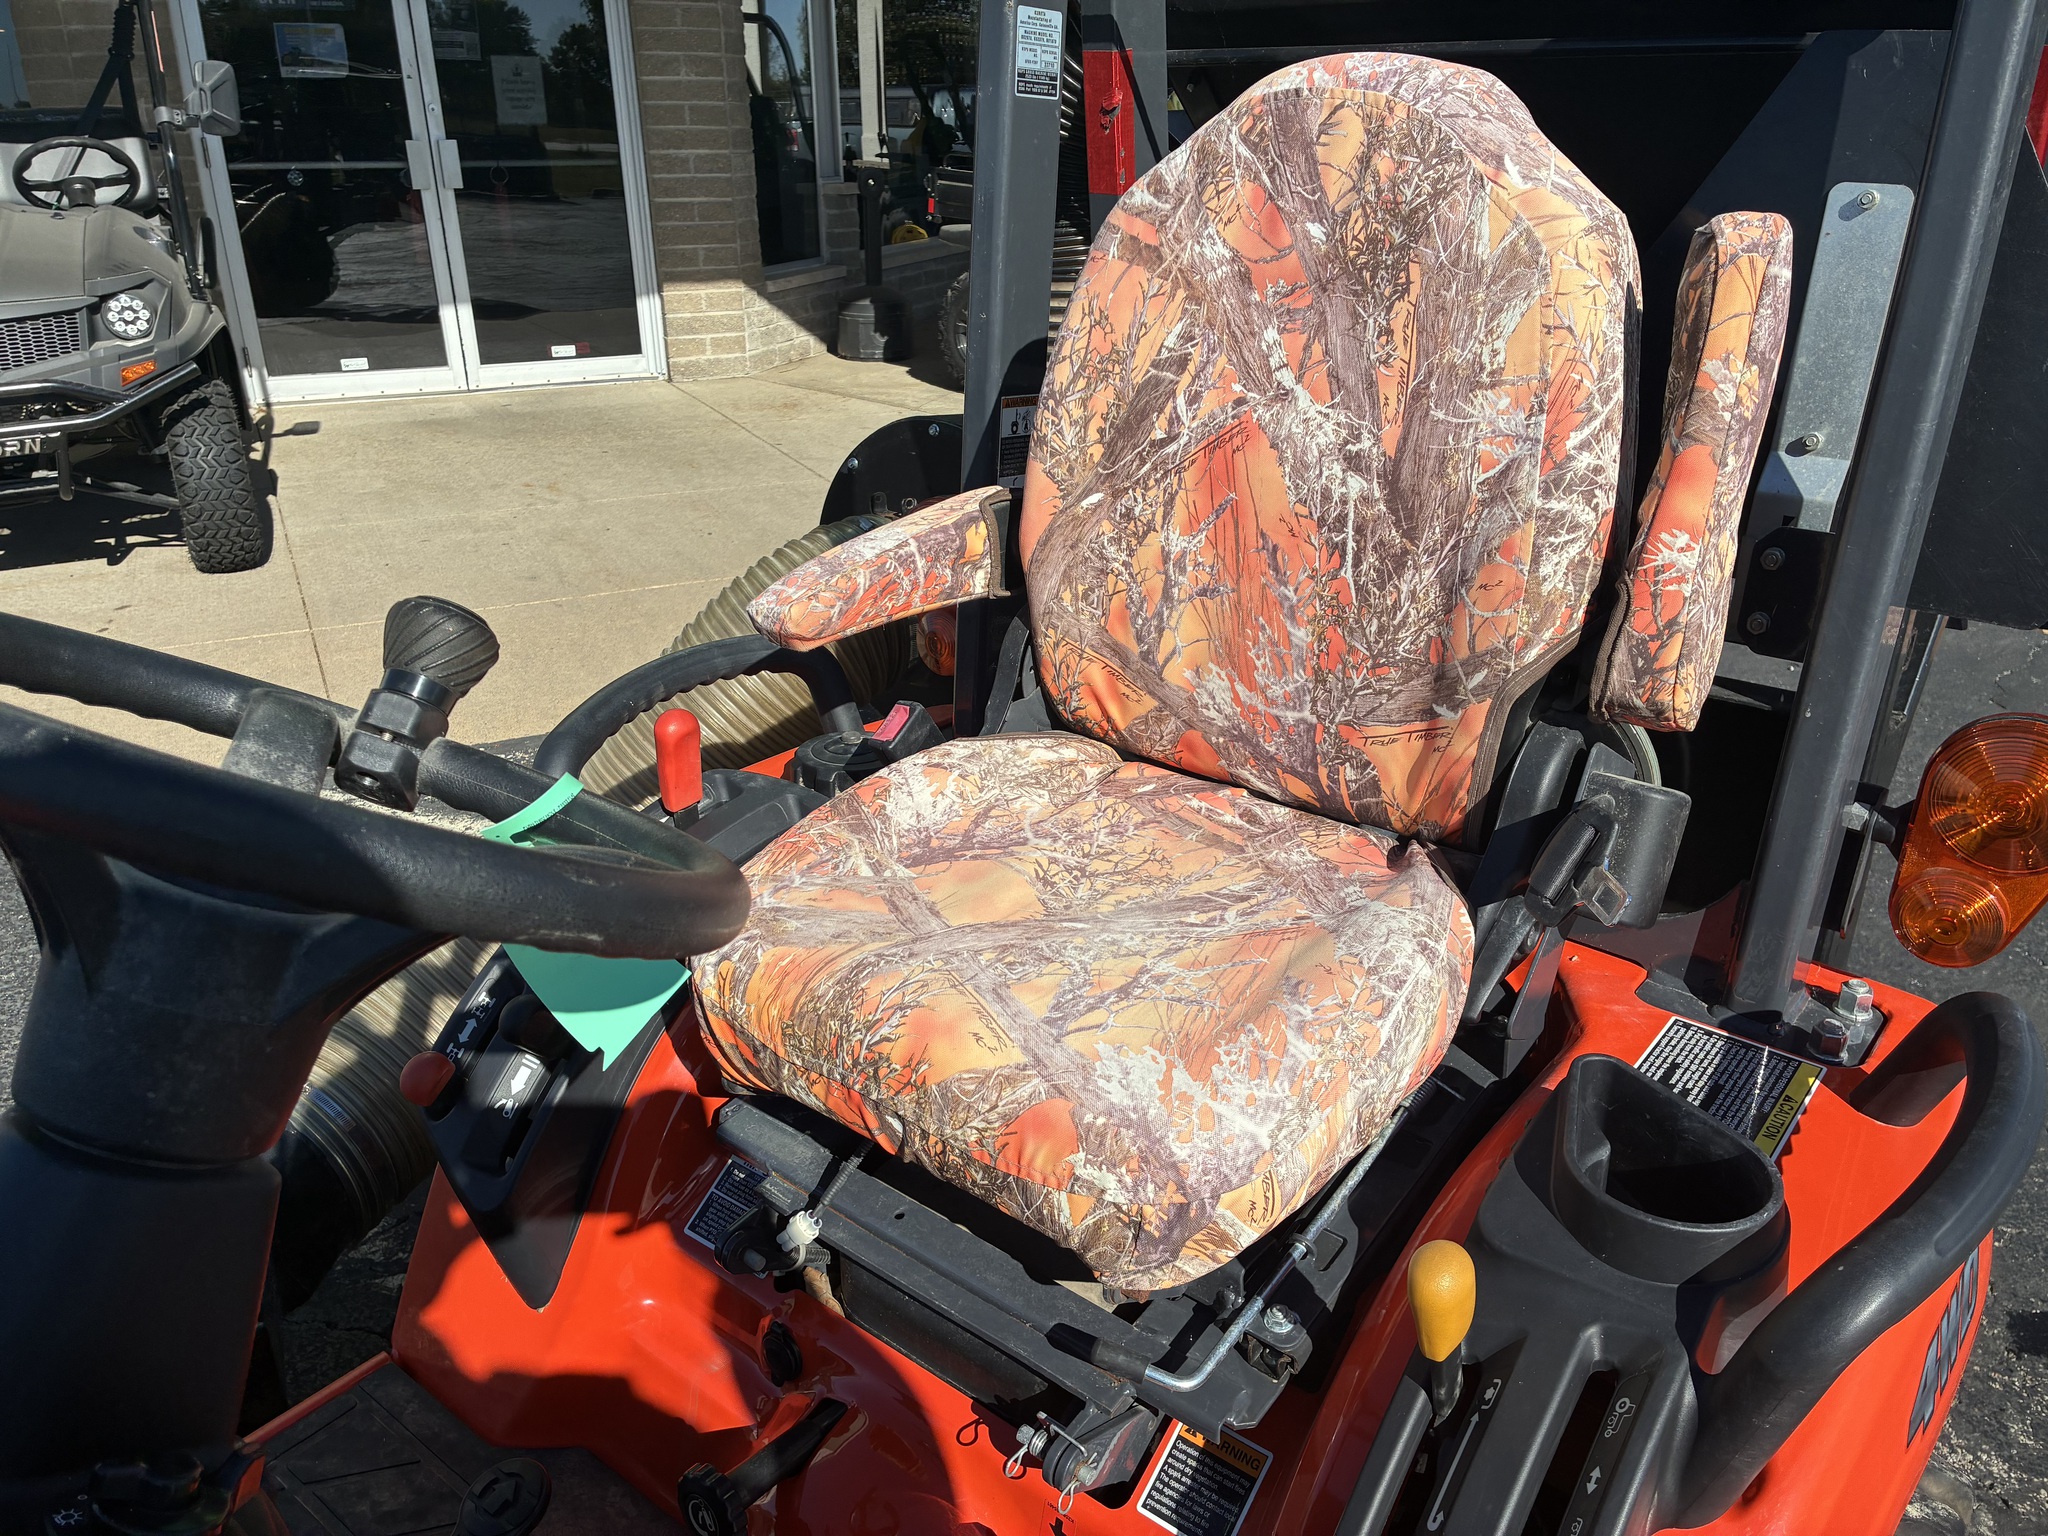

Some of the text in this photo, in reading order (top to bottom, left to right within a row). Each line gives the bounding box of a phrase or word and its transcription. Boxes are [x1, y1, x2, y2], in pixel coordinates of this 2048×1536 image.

[0, 437, 41, 457] RN
[1358, 726, 1452, 747] TRUE TIMBER
[1768, 1076, 1788, 1099] PERSONAL
[1761, 1101, 1794, 1142] CAUTION
[1170, 1448, 1187, 1461] create
[1174, 1439, 1200, 1458] Operation
[1162, 1463, 1169, 1471] A
[1166, 1466, 1182, 1480] spark
[1166, 1455, 1185, 1470] around
[1182, 1465, 1194, 1477] dry
[1153, 1479, 1164, 1490] fire
[1157, 1471, 1170, 1483] The
[1167, 1477, 1190, 1495] operator
[1144, 1497, 1172, 1517] prevention
[1149, 1488, 1178, 1509] regulations
